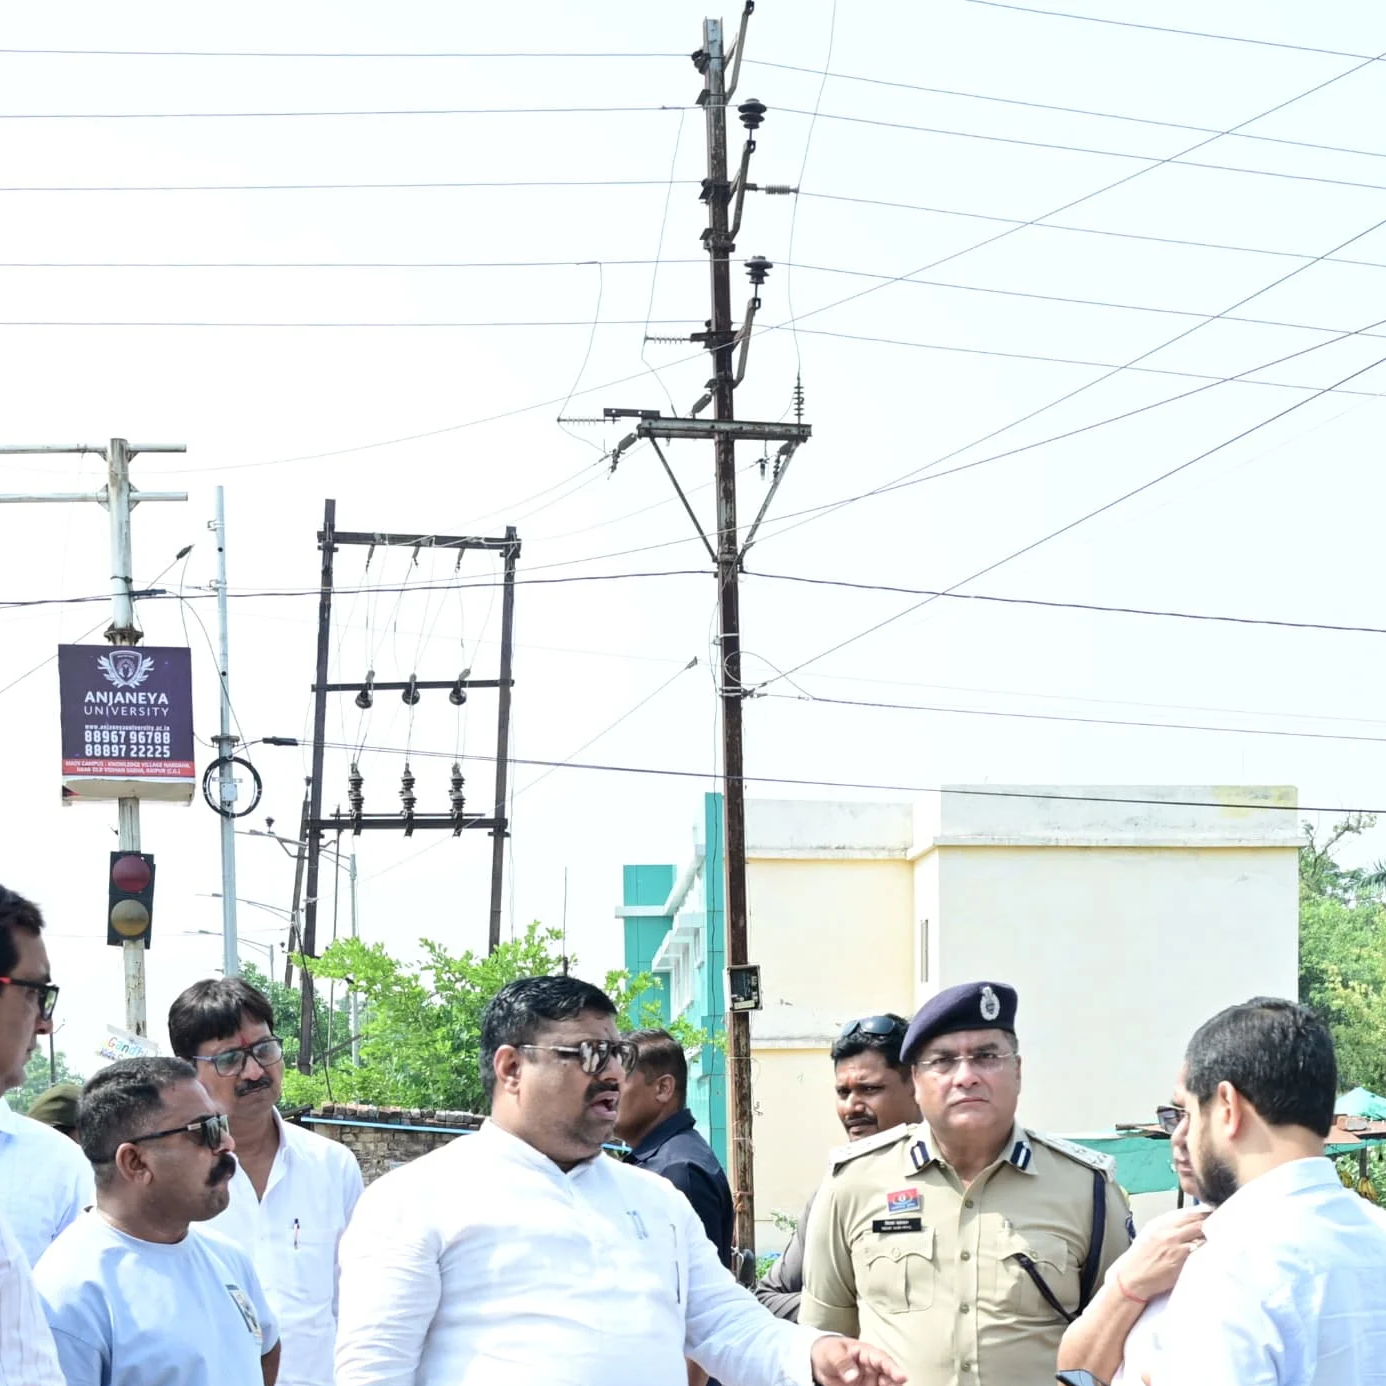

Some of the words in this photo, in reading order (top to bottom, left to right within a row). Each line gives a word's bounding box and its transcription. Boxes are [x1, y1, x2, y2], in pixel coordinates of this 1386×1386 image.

[84, 691, 168, 706] ANJANEYA
[84, 706, 169, 717] UNIVERSITY
[84, 730, 126, 743] 88967
[129, 731, 170, 744] 96788
[85, 744, 126, 757] 88897
[130, 745, 170, 758] 22225
